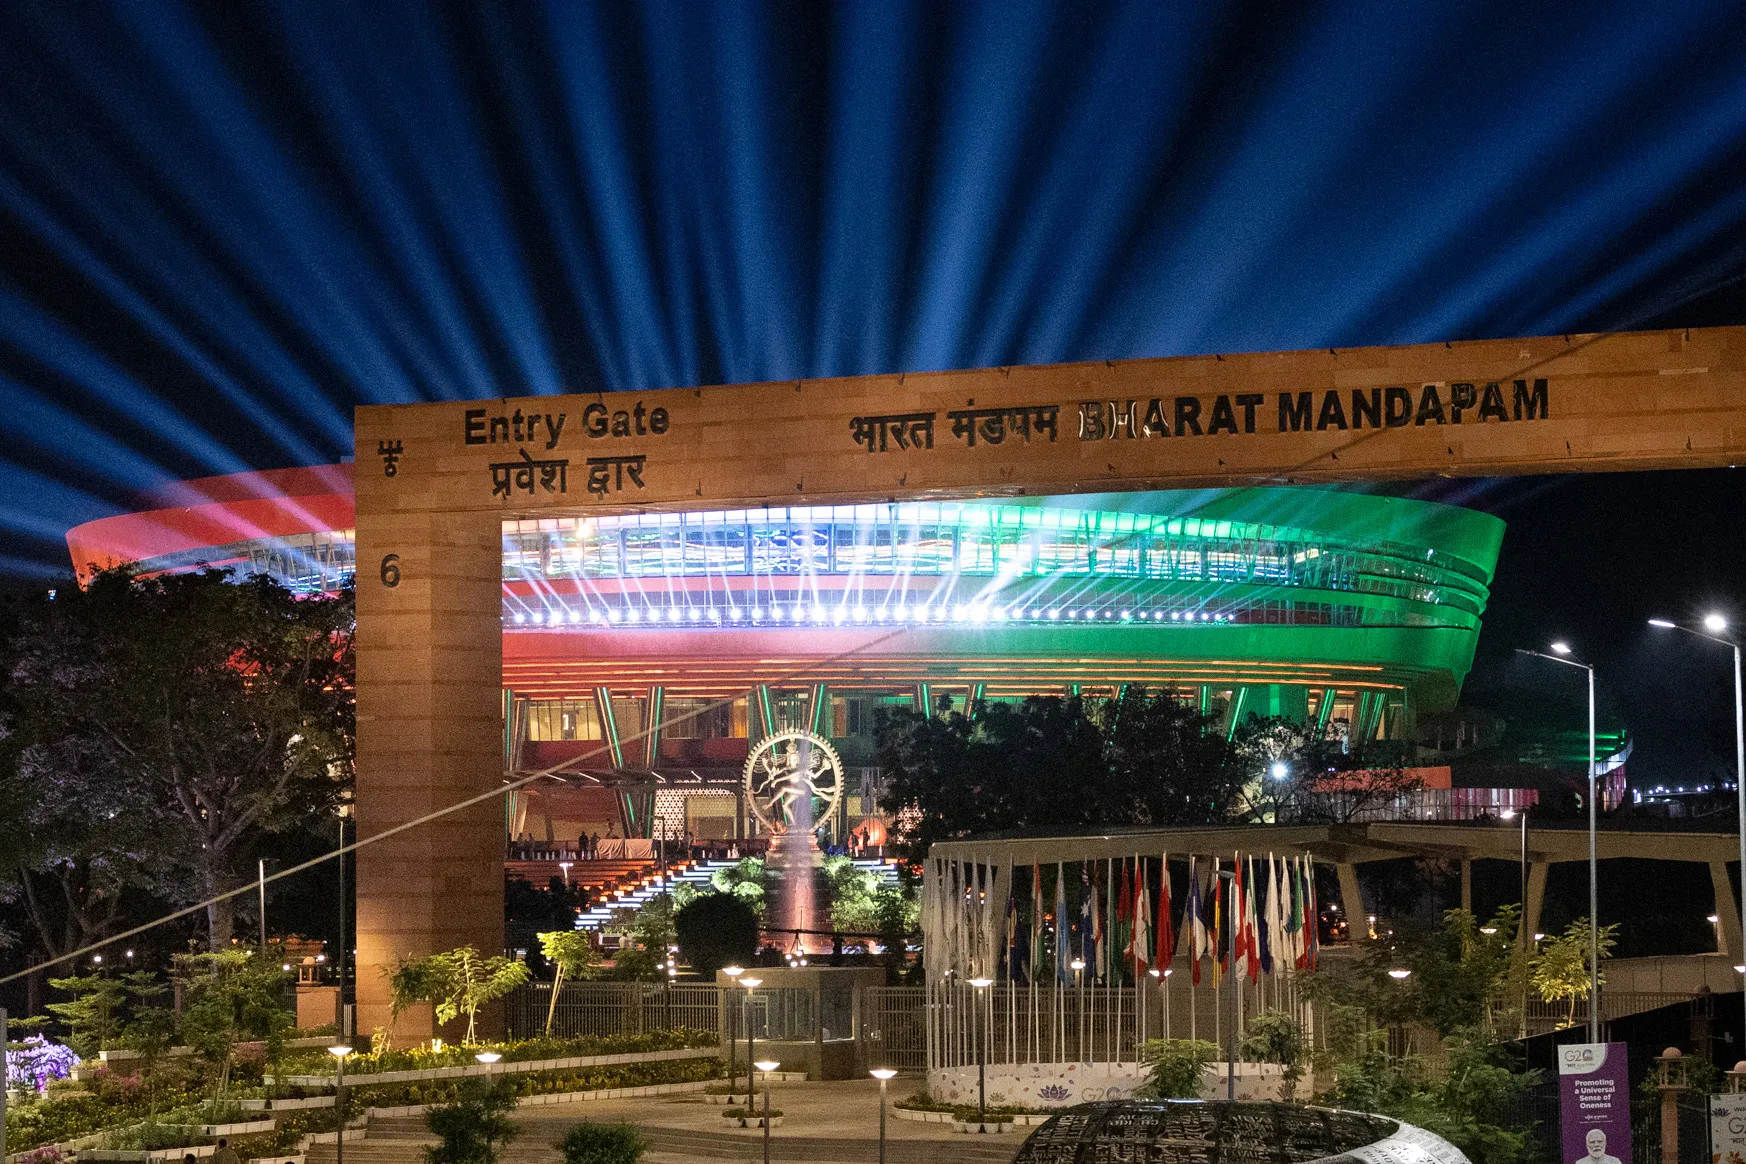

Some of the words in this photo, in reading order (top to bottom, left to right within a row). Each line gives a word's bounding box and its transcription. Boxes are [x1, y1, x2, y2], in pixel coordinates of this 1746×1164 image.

[464, 409, 566, 449] Entry
[582, 401, 670, 439] Gate
[849, 412, 936, 452] भारत
[946, 398, 1059, 447] मंडपम
[1077, 394, 1264, 440] BHARAT
[1278, 378, 1549, 433] MANDAPAM
[488, 448, 569, 499] प्रवेश
[586, 455, 646, 494] द्वार
[380, 553, 401, 588] 6
[1564, 1049, 1594, 1062] G20
